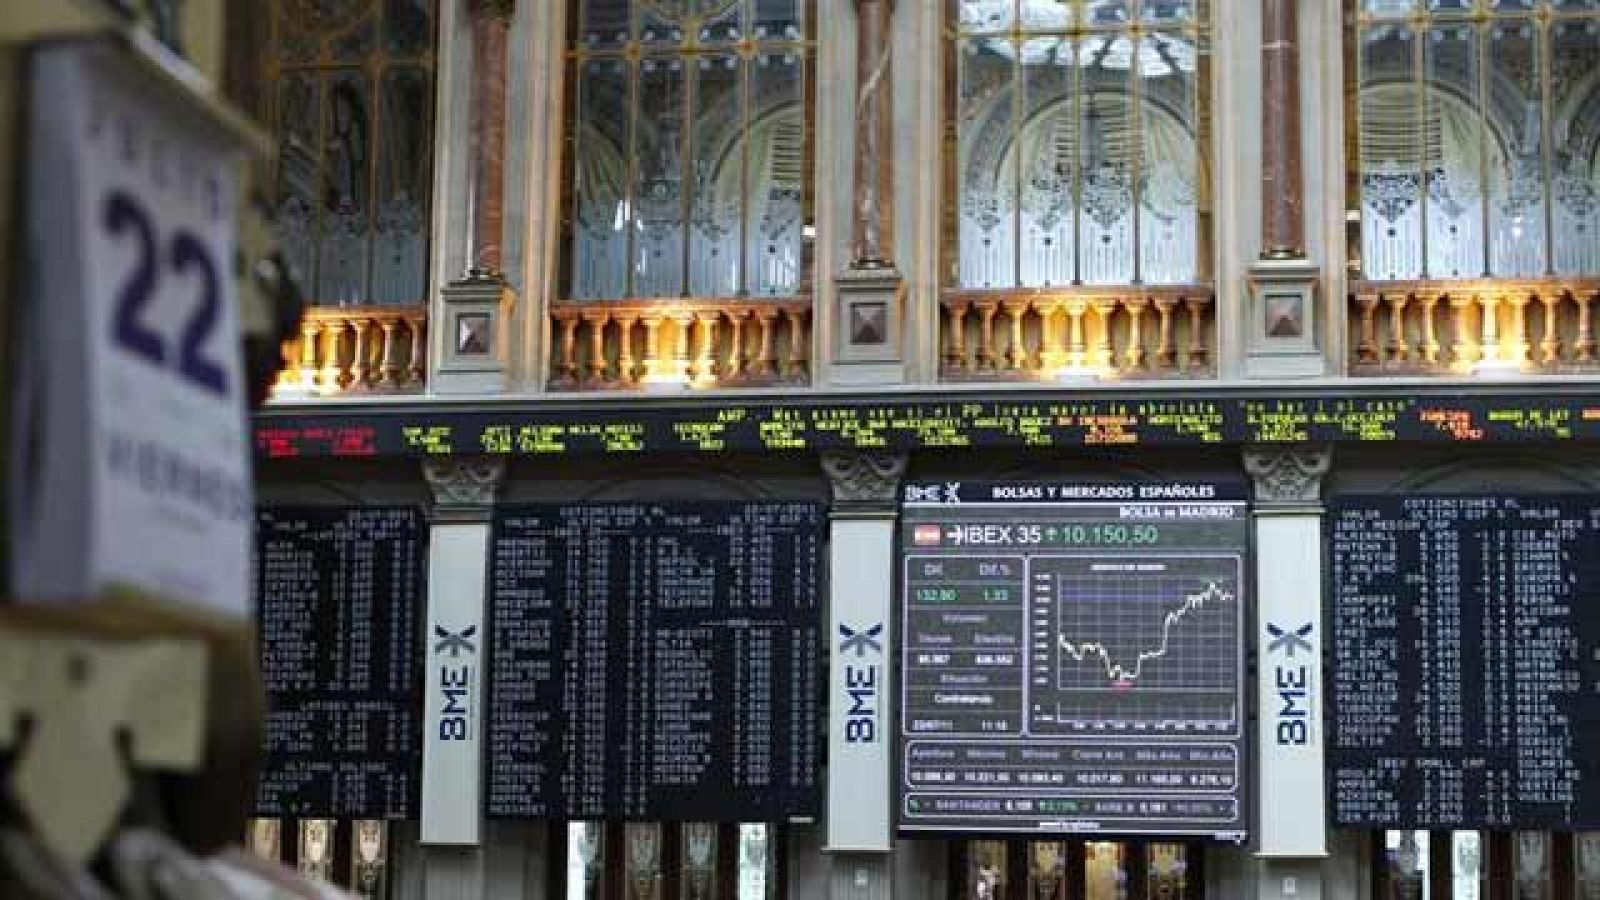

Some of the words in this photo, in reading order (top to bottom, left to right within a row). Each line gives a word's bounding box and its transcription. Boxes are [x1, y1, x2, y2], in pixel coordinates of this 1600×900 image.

[103, 192, 229, 397] 22
[992, 487, 1043, 499] BOLSAS
[1048, 487, 1057, 498] Y
[1062, 487, 1134, 499] MERCADOS
[1139, 483, 1216, 499] ESPAÑOLES
[1179, 506, 1235, 518] MADRID
[964, 525, 1013, 544] IBEX
[1017, 525, 1042, 544] 35
[440, 665, 468, 741] BME
[846, 665, 876, 743] BME
[1277, 666, 1307, 745] BME
